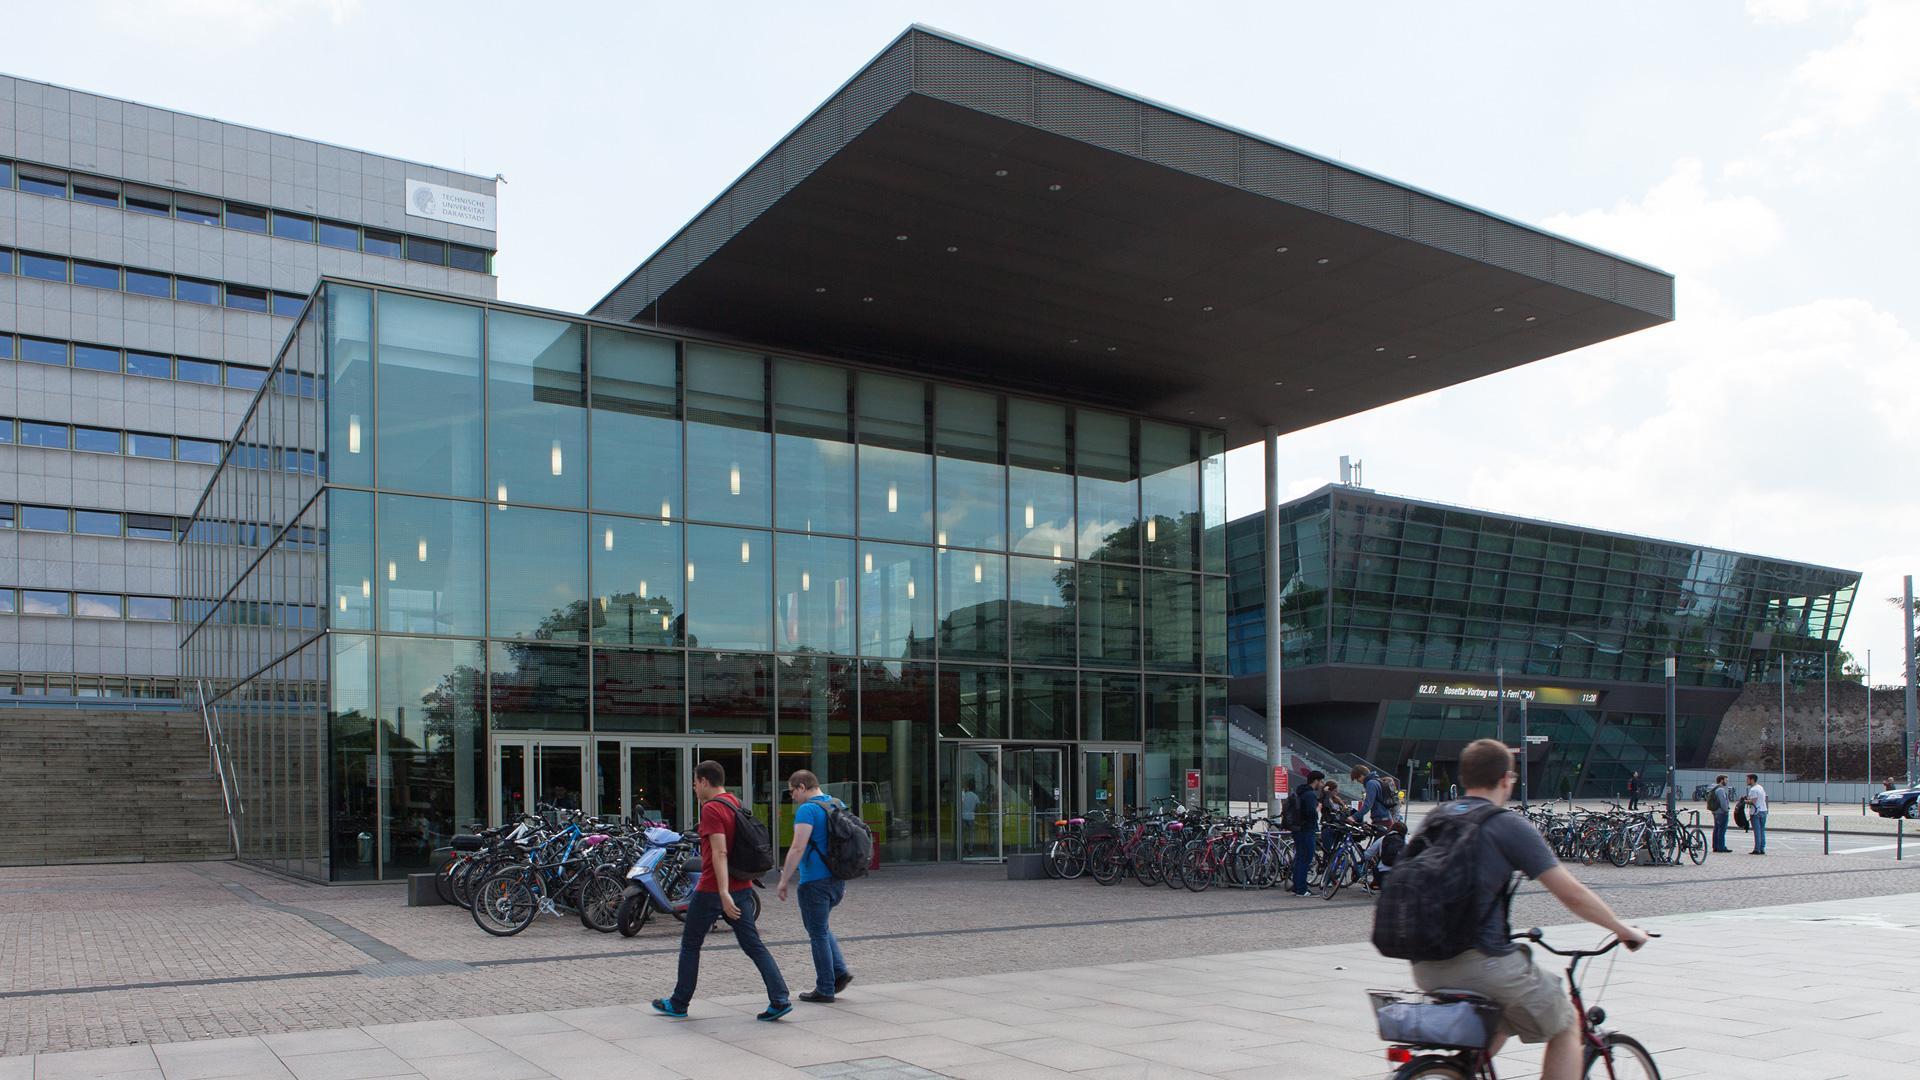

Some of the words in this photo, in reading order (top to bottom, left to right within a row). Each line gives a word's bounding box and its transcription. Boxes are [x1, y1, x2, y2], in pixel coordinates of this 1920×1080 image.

[442, 193, 485, 208] TECHNISCHE
[442, 208, 486, 222] DARMSTADT
[1419, 685, 1437, 695] 02.07.
[1443, 686, 1488, 698] Rosetta-Vortrag
